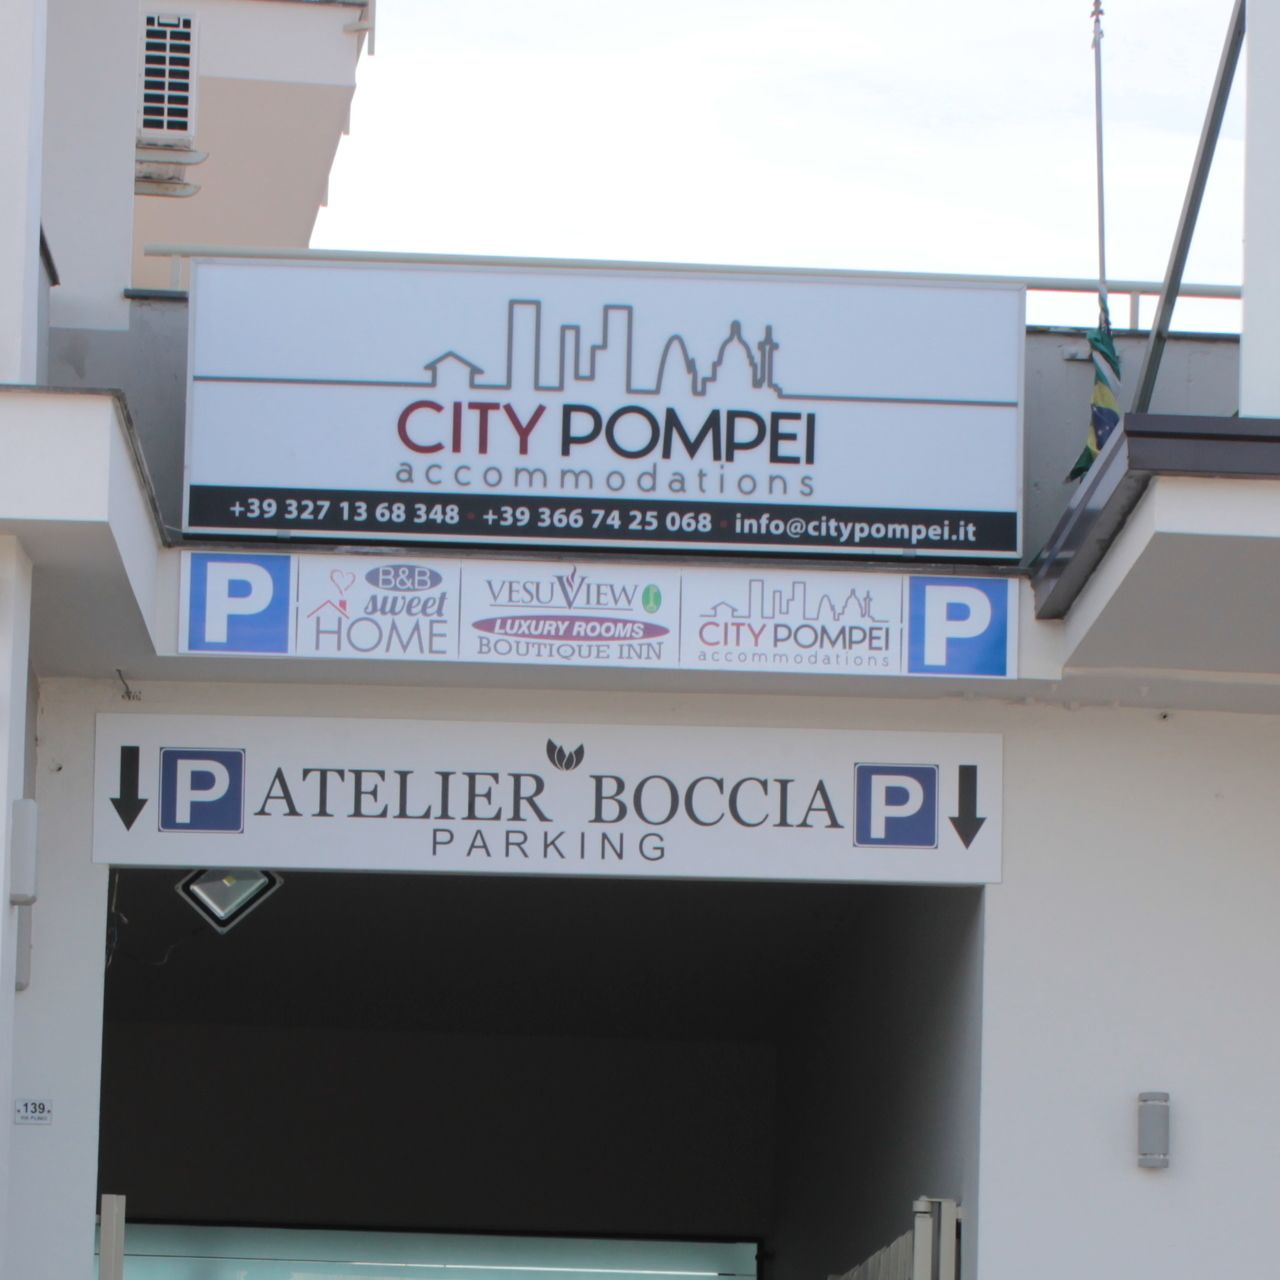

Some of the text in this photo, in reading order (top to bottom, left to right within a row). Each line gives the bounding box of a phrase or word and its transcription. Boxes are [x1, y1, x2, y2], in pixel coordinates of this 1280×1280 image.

[397, 400, 816, 465] CITY POMPEI
[396, 458, 815, 497] accommodations
[230, 498, 976, 544] +39 327 13 68 348 +39 366 74 25 068 info@citypompei.it
[379, 567, 431, 590] B&B
[205, 562, 274, 643] P
[364, 592, 447, 617] sweet
[315, 616, 447, 655] HOME
[494, 618, 644, 639] LUXURY ROOMS
[699, 622, 889, 651] CITY POMPEI
[924, 585, 991, 666] P
[477, 636, 664, 660] BOUTIQUE INN
[698, 650, 889, 667] accommodations
[176, 759, 230, 825] P
[254, 766, 844, 831] ATELIER BOCCIA
[871, 774, 924, 839] P
[432, 828, 665, 861] PARKING
